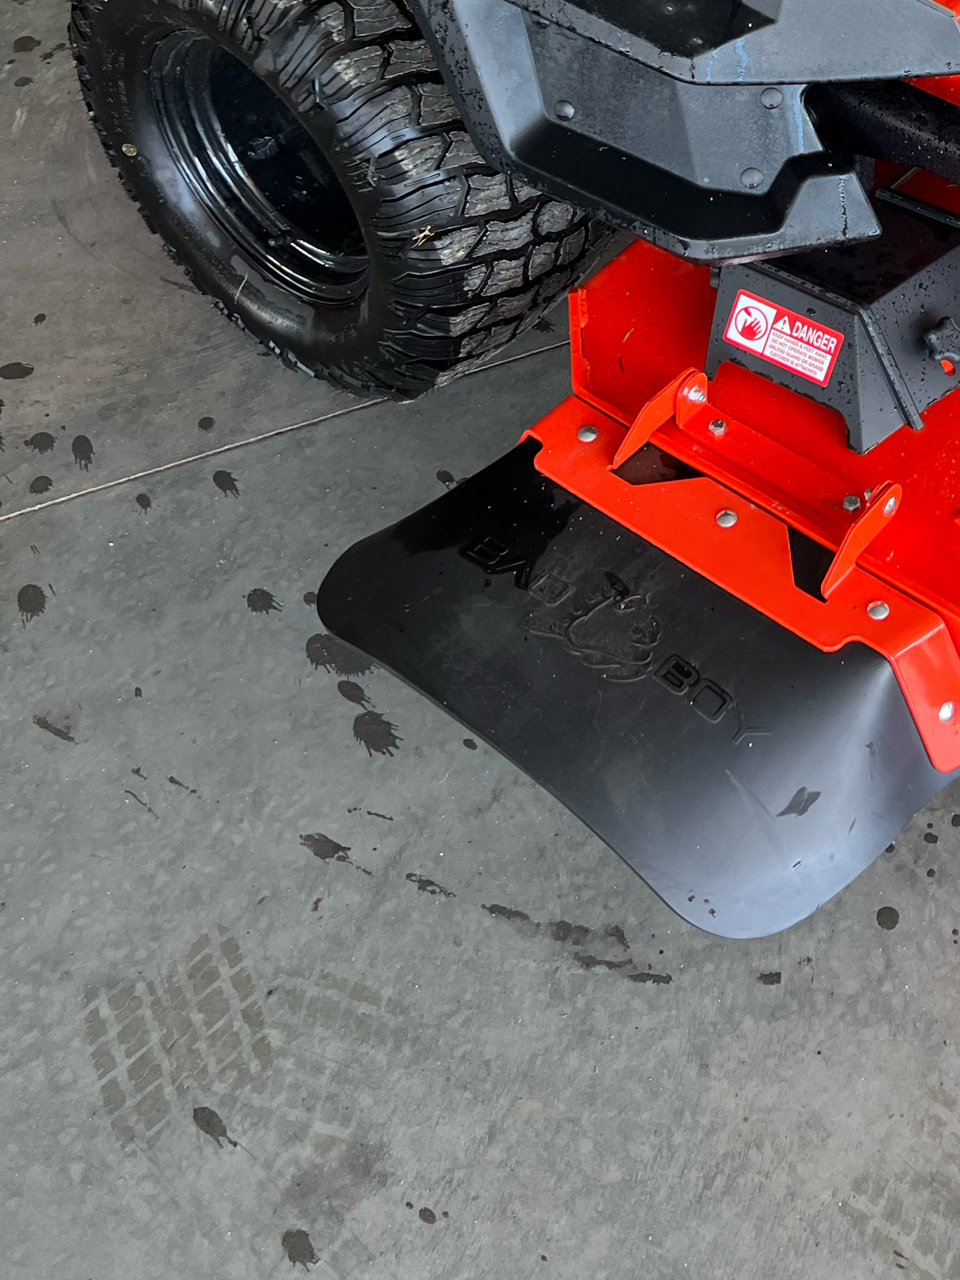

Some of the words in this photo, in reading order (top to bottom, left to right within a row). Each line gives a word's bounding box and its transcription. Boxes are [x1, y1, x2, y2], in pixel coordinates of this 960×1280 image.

[772, 331, 783, 339] KEEP
[803, 345, 814, 353] FEET
[791, 320, 838, 354] DANGER
[768, 343, 785, 354] UNLESS
[785, 351, 801, 361] GUARD
[808, 361, 823, 371] GRASS
[769, 350, 789, 363] CATCHER
[787, 345, 807, 357] OPERATE
[807, 354, 824, 364] MOWER
